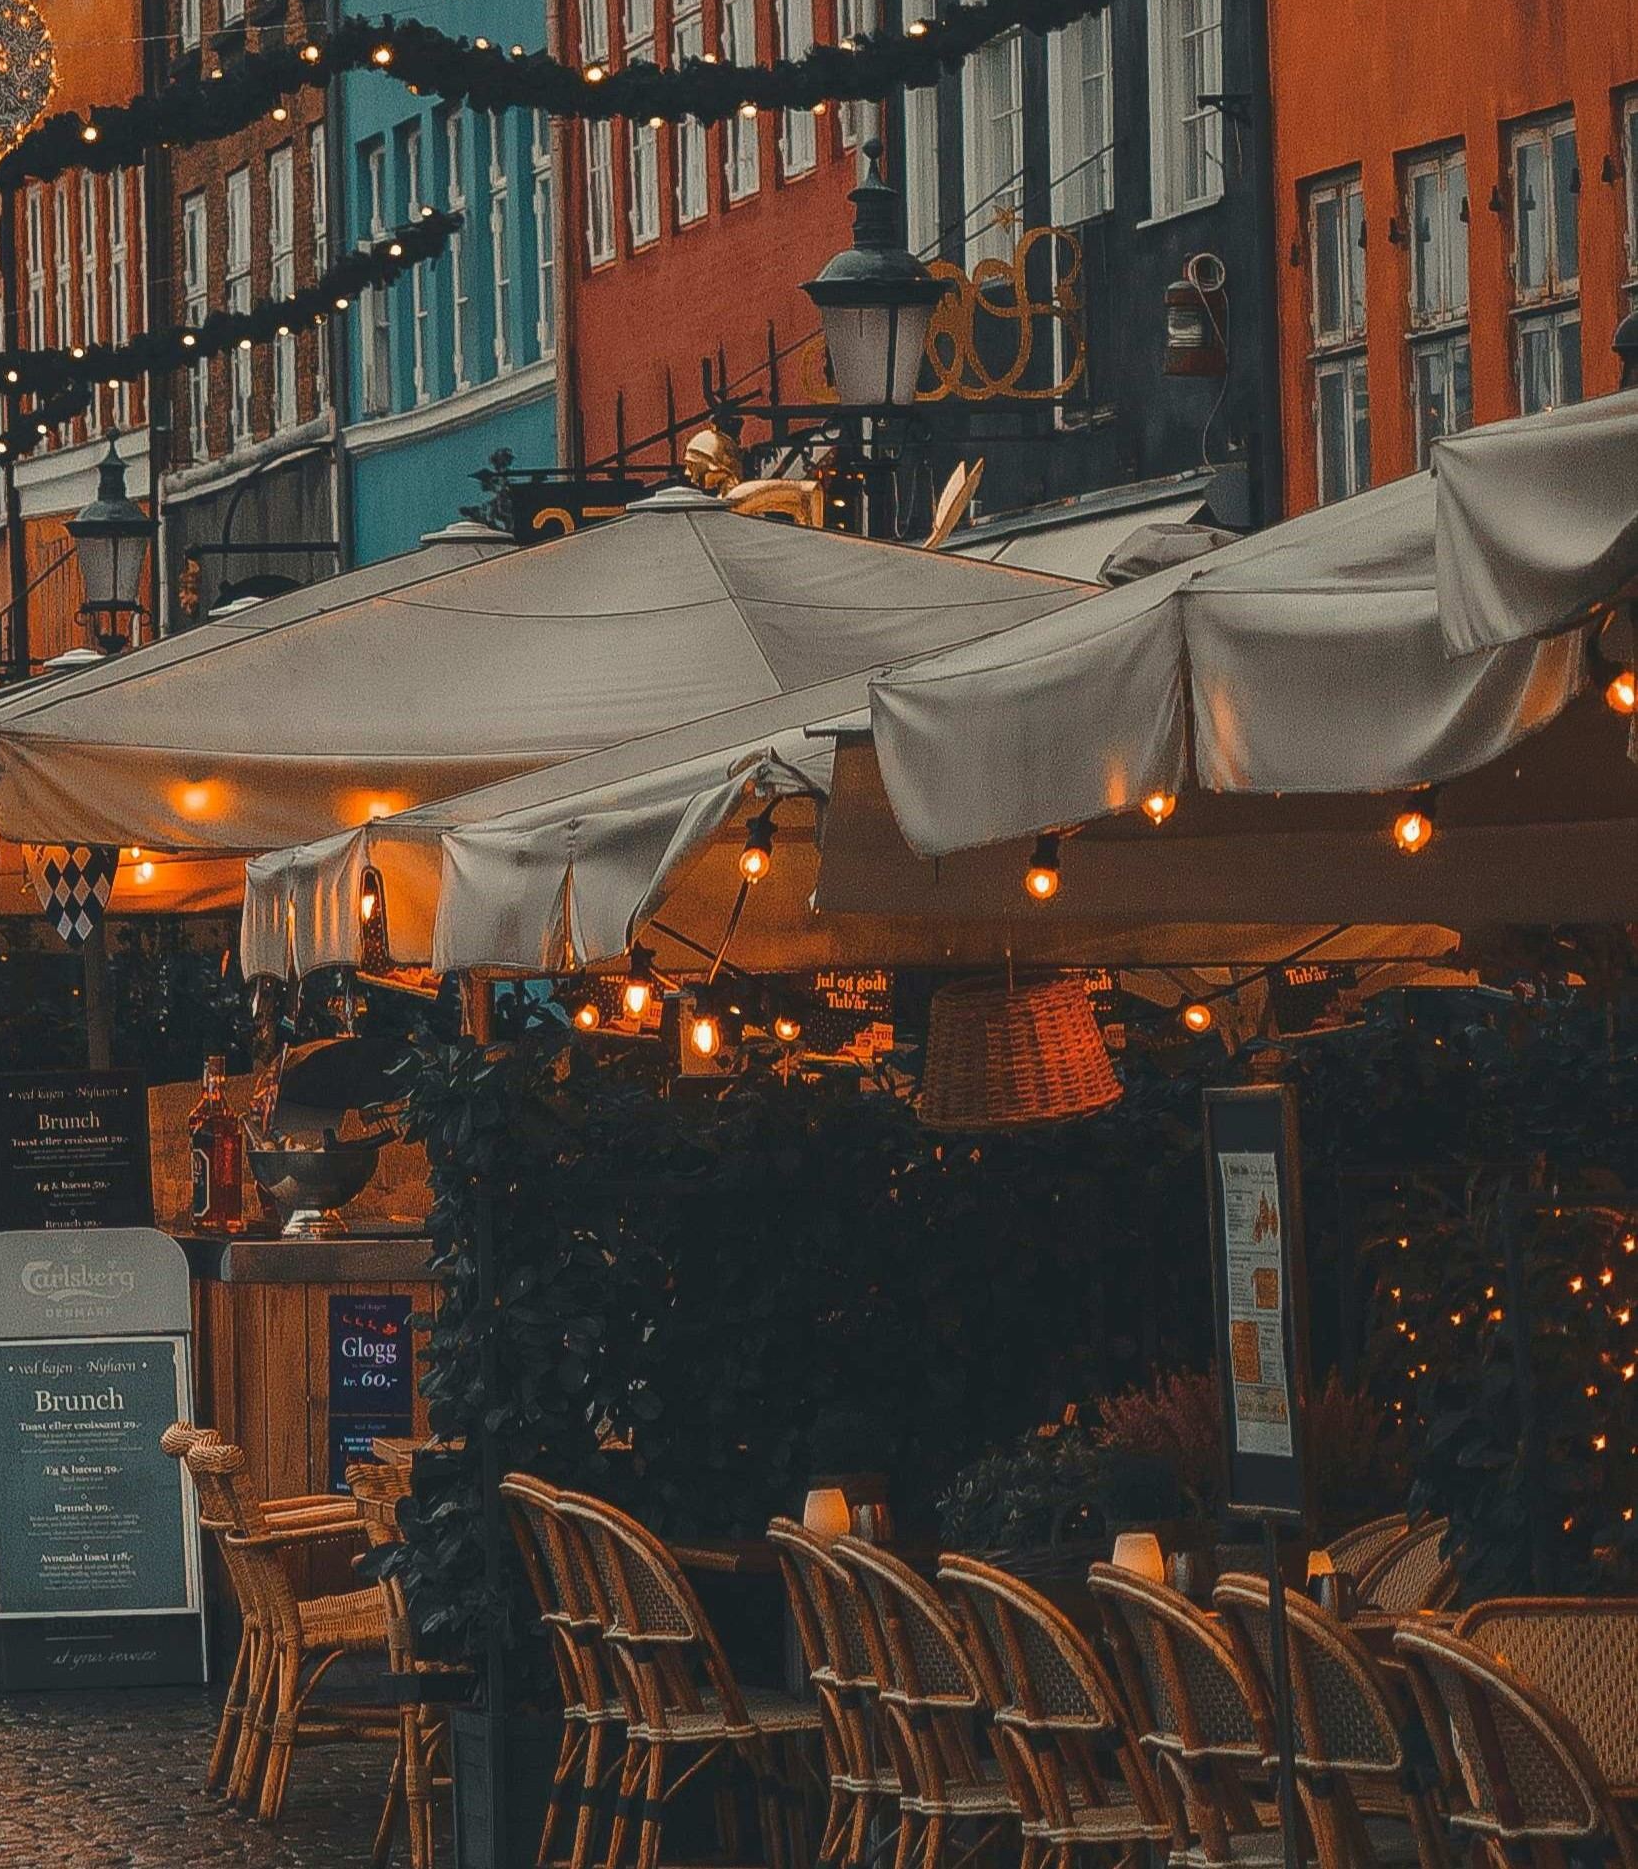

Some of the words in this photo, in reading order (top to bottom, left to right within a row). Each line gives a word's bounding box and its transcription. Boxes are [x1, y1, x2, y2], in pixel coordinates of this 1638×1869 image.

[815, 972, 834, 990] jul
[837, 976, 853, 992] og
[856, 974, 887, 993] godt
[38, 1111, 100, 1130] Brunch
[22, 1261, 135, 1300] Carlsberg
[86, 1357, 136, 1379] Nyhavn
[362, 1370, 398, 1389] 60,-
[35, 1387, 124, 1412] Brunch
[19, 1422, 47, 1432] Toast
[49, 1421, 72, 1430] eller
[74, 1420, 120, 1430] croissant
[72, 1465, 101, 1473] bacon
[54, 1503, 92, 1513] Brunch
[40, 1553, 82, 1563] Avocado
[84, 1553, 109, 1562] toast
